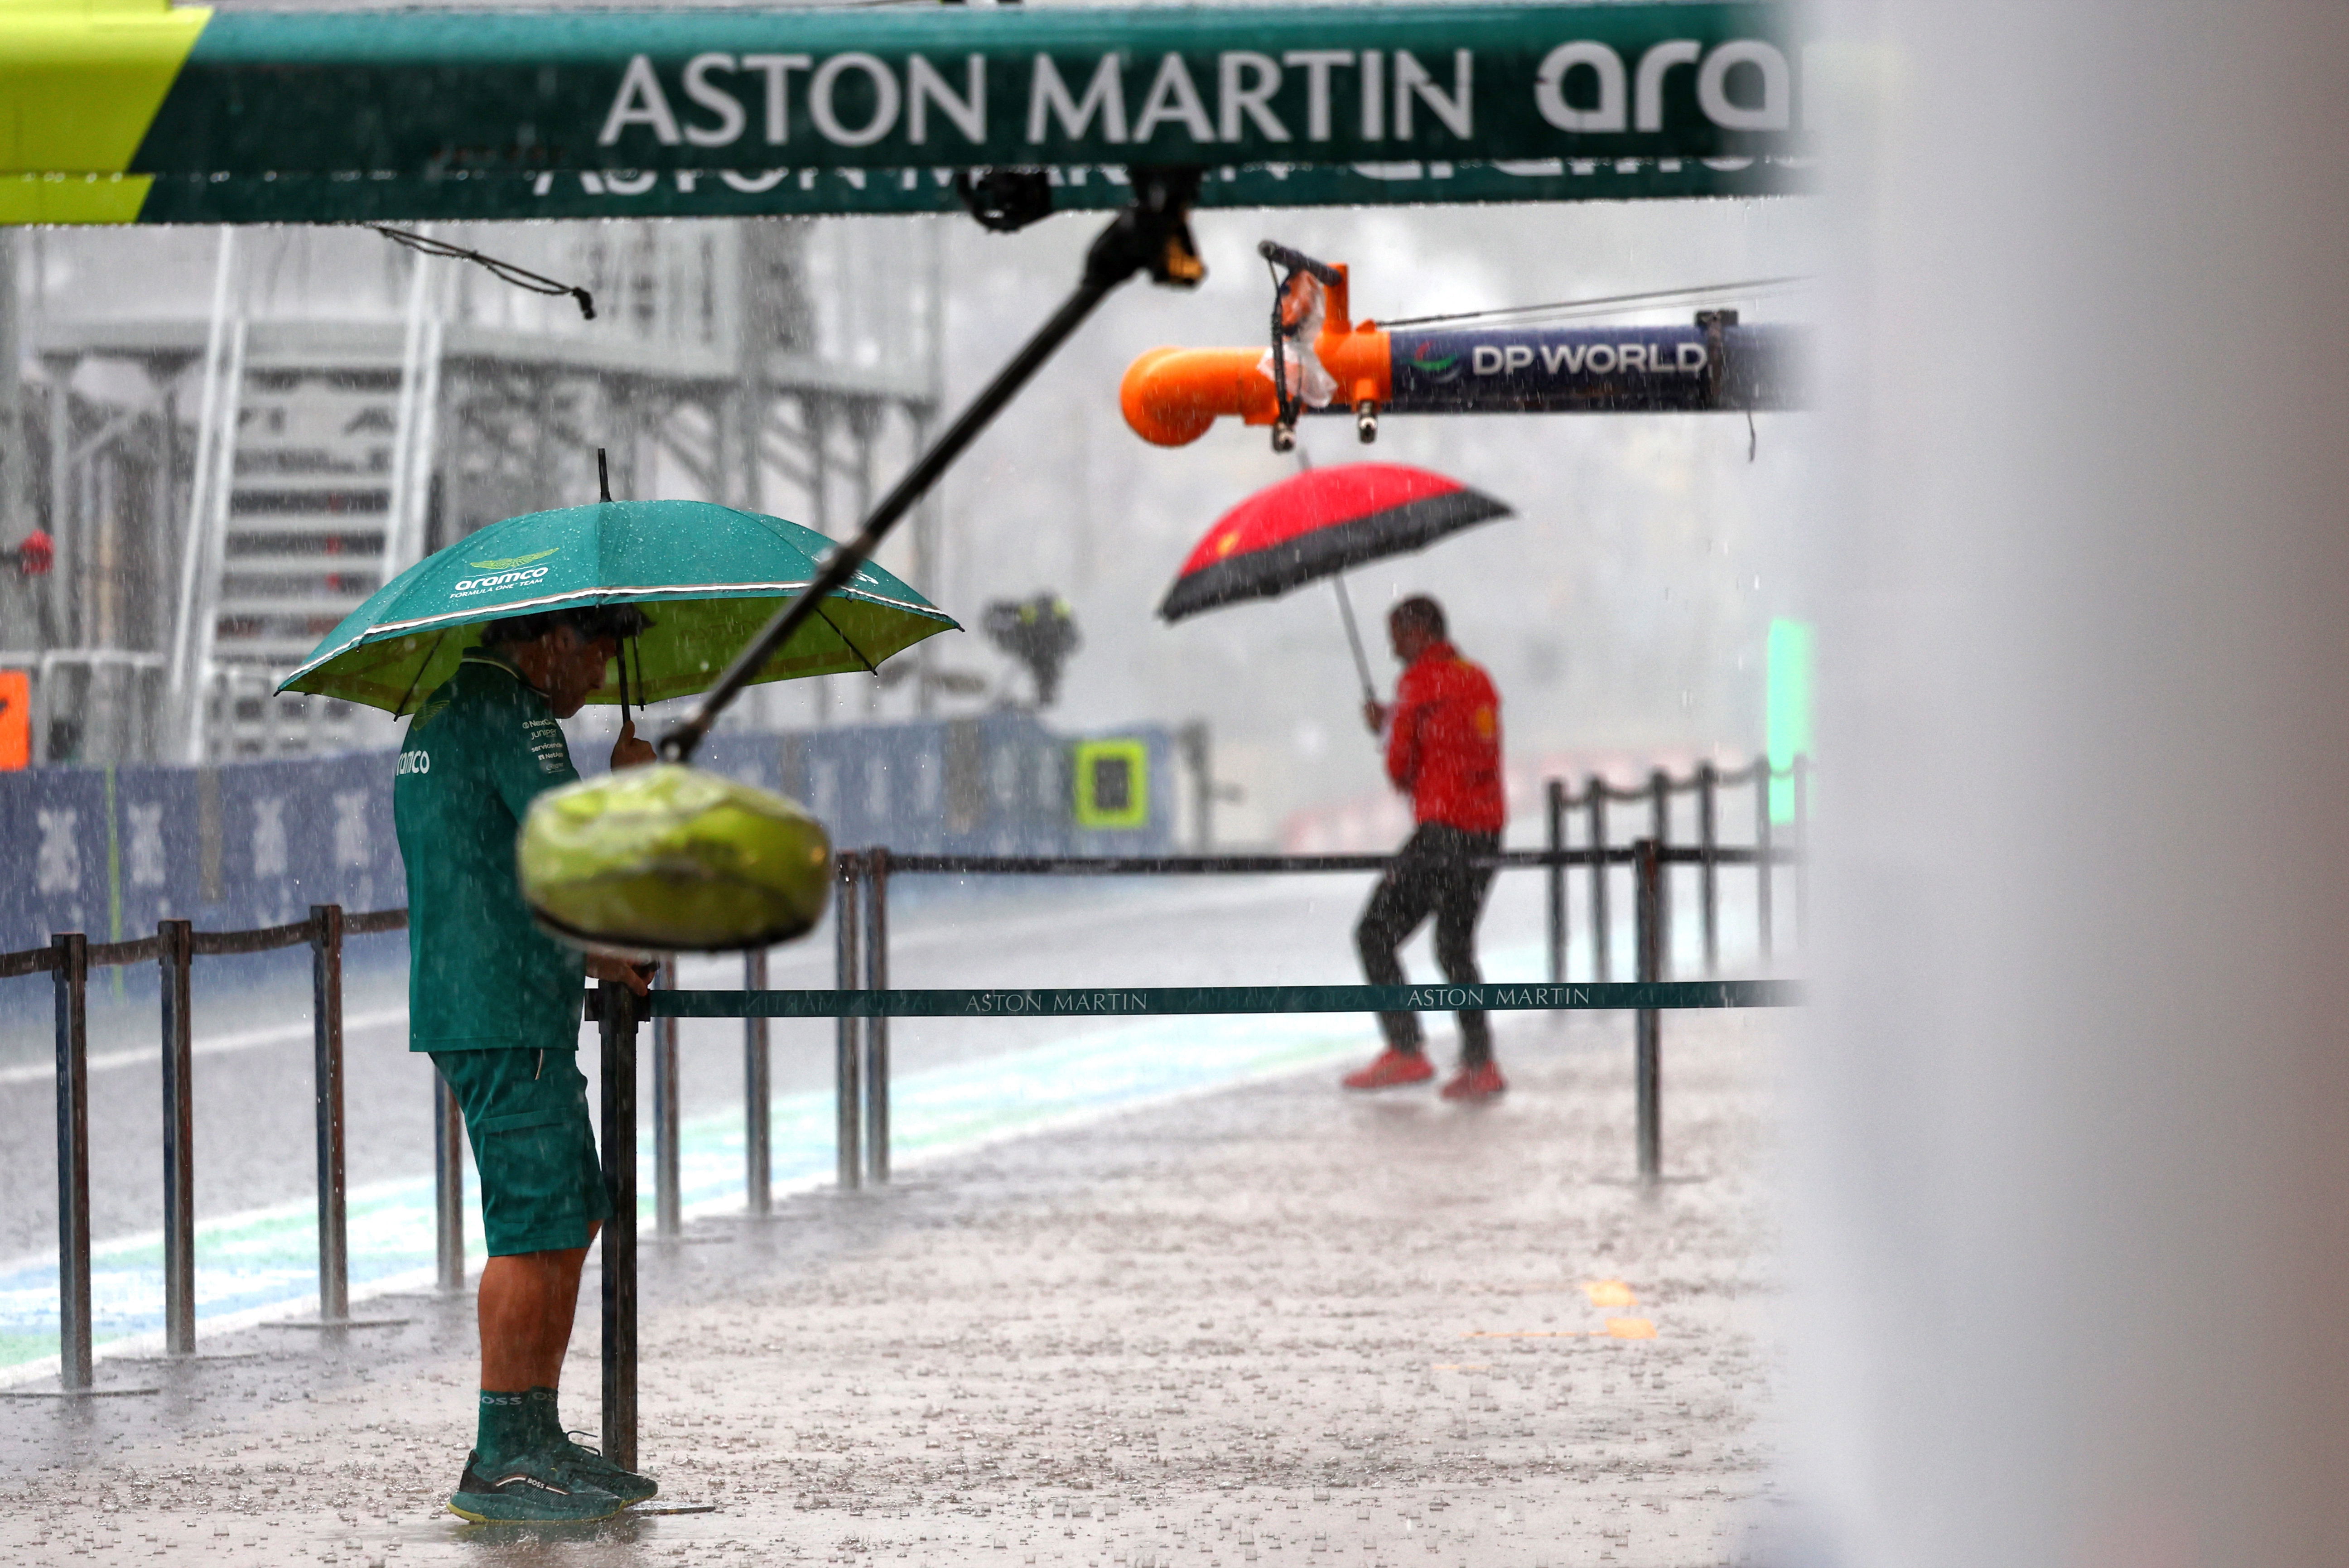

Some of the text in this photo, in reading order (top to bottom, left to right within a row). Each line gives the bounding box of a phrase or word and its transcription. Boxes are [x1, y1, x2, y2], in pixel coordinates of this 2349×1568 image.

[598, 39, 1790, 146] ASTON MARTIN ara
[1473, 343, 1707, 375] DP WORLD
[450, 587, 493, 598] FORMULA
[520, 578, 543, 586] TEAM
[455, 567, 549, 590] aramco
[965, 993, 1147, 1012] ASTON MARTIN
[1408, 988, 1589, 1006] ASTON MARTIN
[527, 1478, 545, 1489] BOSS
